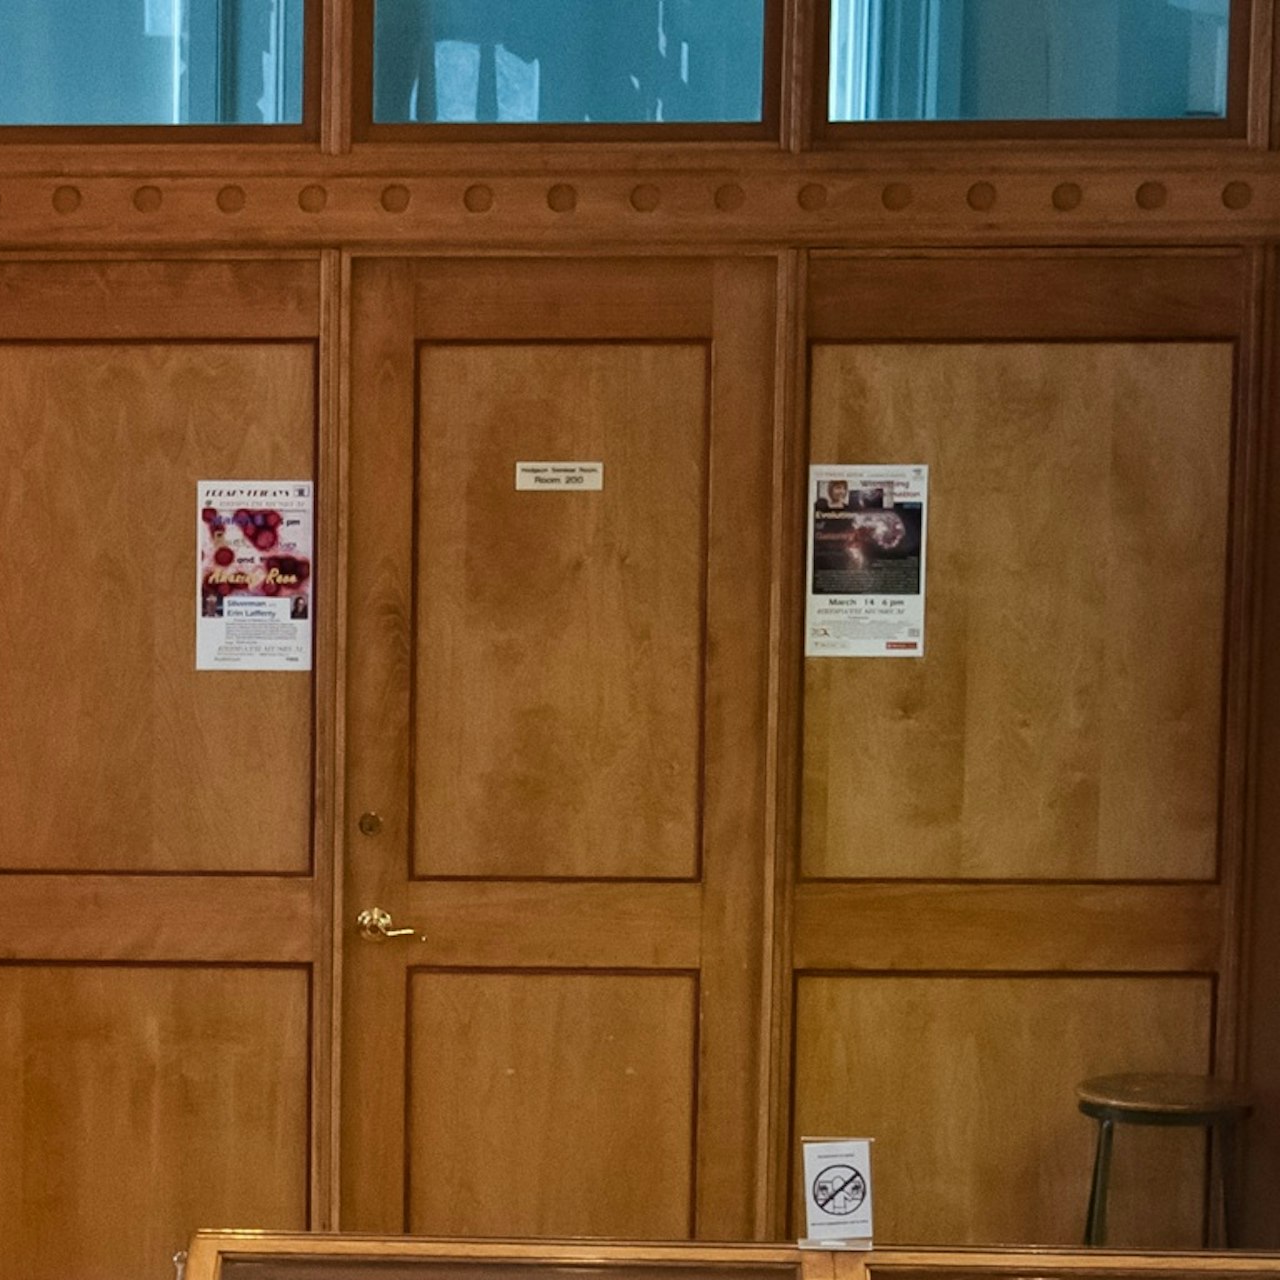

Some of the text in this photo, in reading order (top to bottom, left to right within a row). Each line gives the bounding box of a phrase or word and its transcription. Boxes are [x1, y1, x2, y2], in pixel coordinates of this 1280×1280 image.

[534, 476, 584, 484] Room 200
[237, 556, 255, 564] and
[226, 600, 267, 608] Silverman
[828, 598, 857, 606] March
[864, 598, 875, 606] 14
[889, 599, 905, 607] pm
